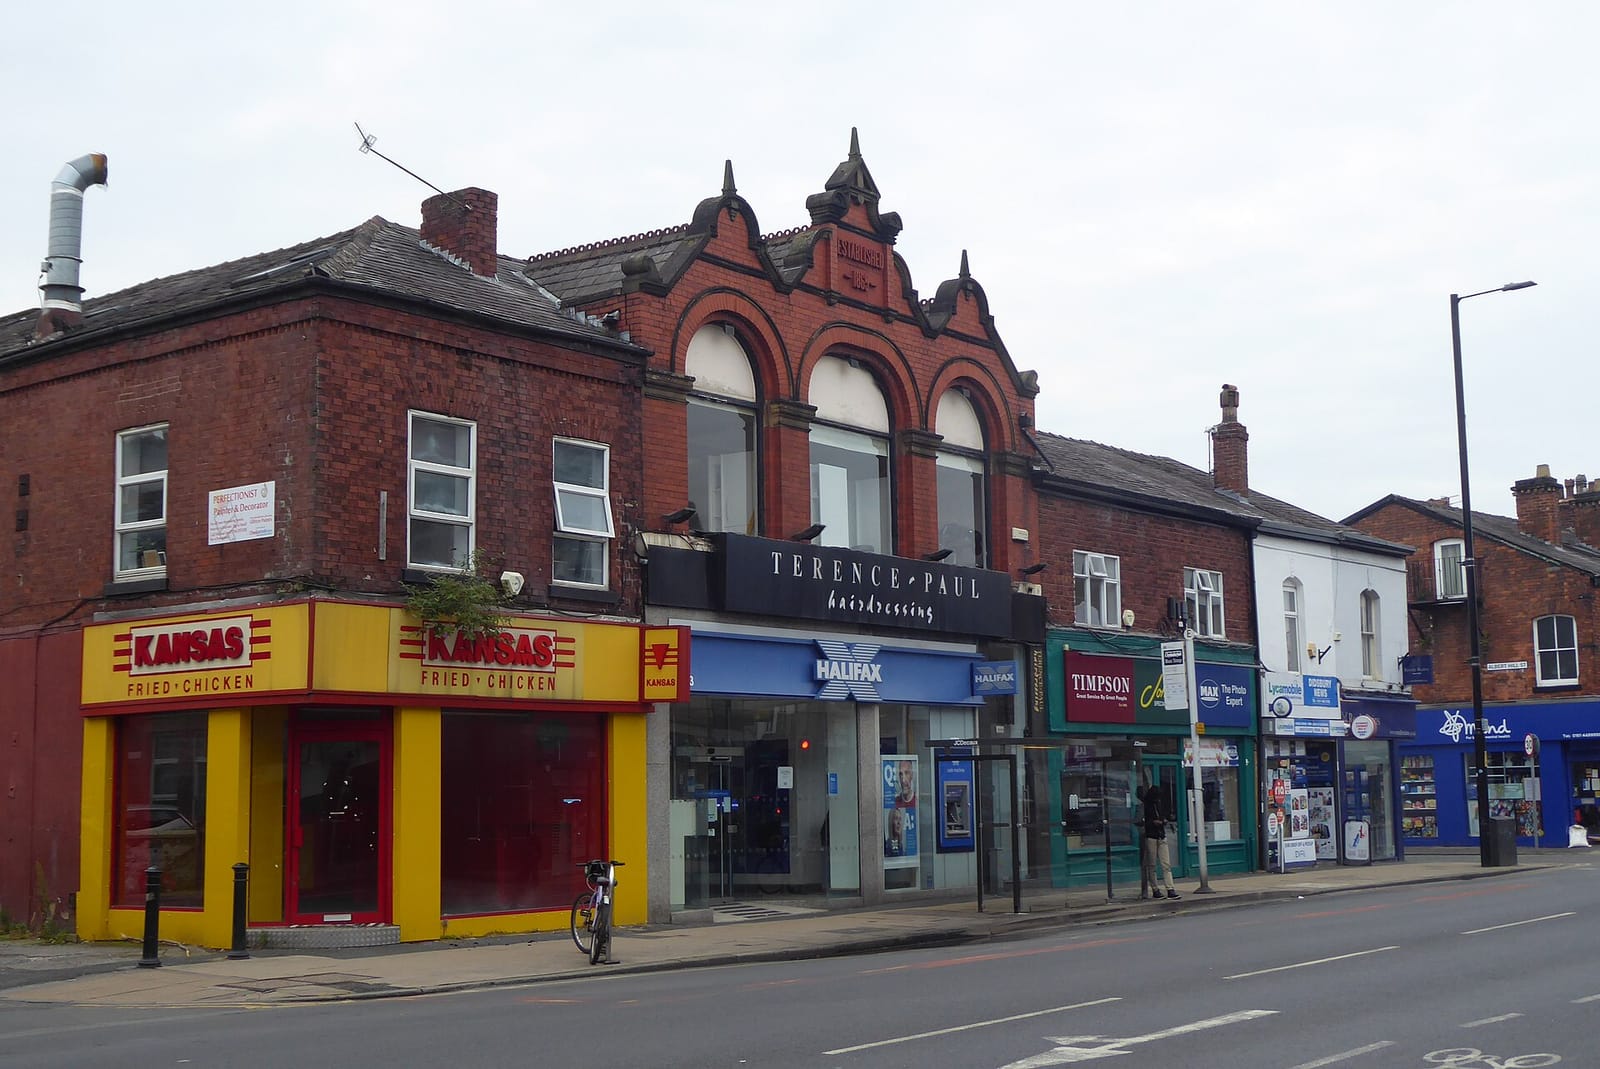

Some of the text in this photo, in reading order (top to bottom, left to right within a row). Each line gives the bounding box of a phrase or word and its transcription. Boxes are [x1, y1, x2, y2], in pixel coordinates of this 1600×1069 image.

[837, 240, 884, 270] ESTABLISHED
[213, 489, 257, 504] PERFECTIONIST
[213, 501, 268, 516] Painter & Decorator
[771, 551, 980, 599] TERENCE PAUL
[828, 590, 934, 624] hairdressing
[1186, 629, 1192, 638] E
[134, 626, 244, 667] KANSAS
[428, 627, 553, 667] KANSAS
[816, 659, 883, 682] HALIFAX
[975, 672, 1015, 683] HALIFAX
[127, 674, 253, 697] FRIED CHICKEN
[421, 670, 556, 691] FRIED CHICKEN
[646, 679, 676, 687] KANSAS
[1071, 673, 1130, 694] TIMPSON
[1308, 679, 1332, 688] DIDSBURY
[1200, 686, 1219, 697] MAX
[1221, 684, 1247, 695] The Photo
[1268, 682, 1302, 695] Lycamobile
[1313, 688, 1328, 698] NEWS
[1226, 696, 1243, 707] Expert
